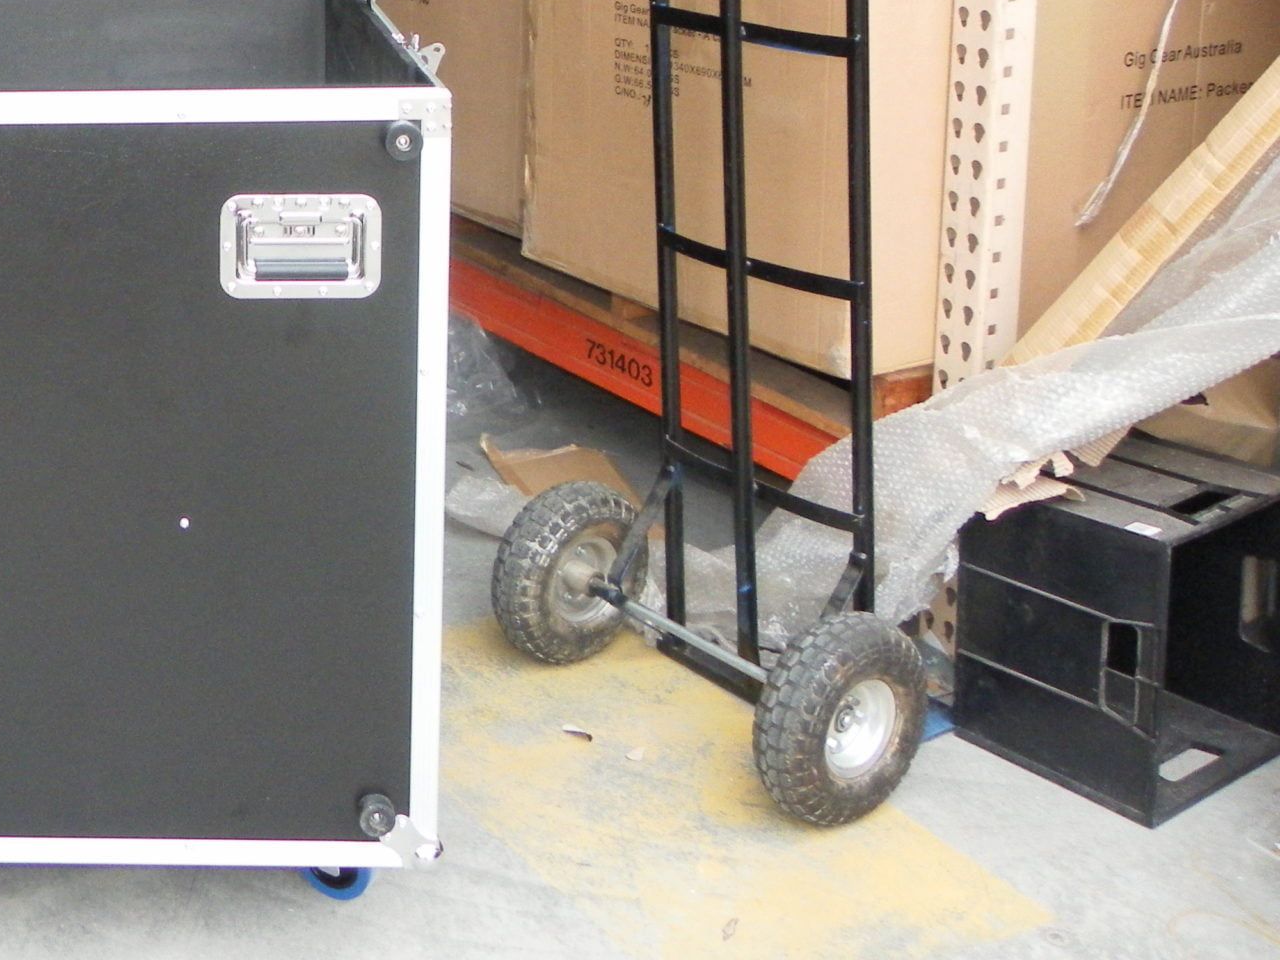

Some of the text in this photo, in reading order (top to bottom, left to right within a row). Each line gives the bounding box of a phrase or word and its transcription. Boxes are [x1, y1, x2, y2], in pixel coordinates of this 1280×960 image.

[614, 1, 629, 14] Gig
[637, 18, 650, 28] NA
[1124, 51, 1147, 70] Gig
[1183, 39, 1243, 60] Australia
[1157, 84, 1203, 105] NAME:
[585, 338, 653, 387] 731403
